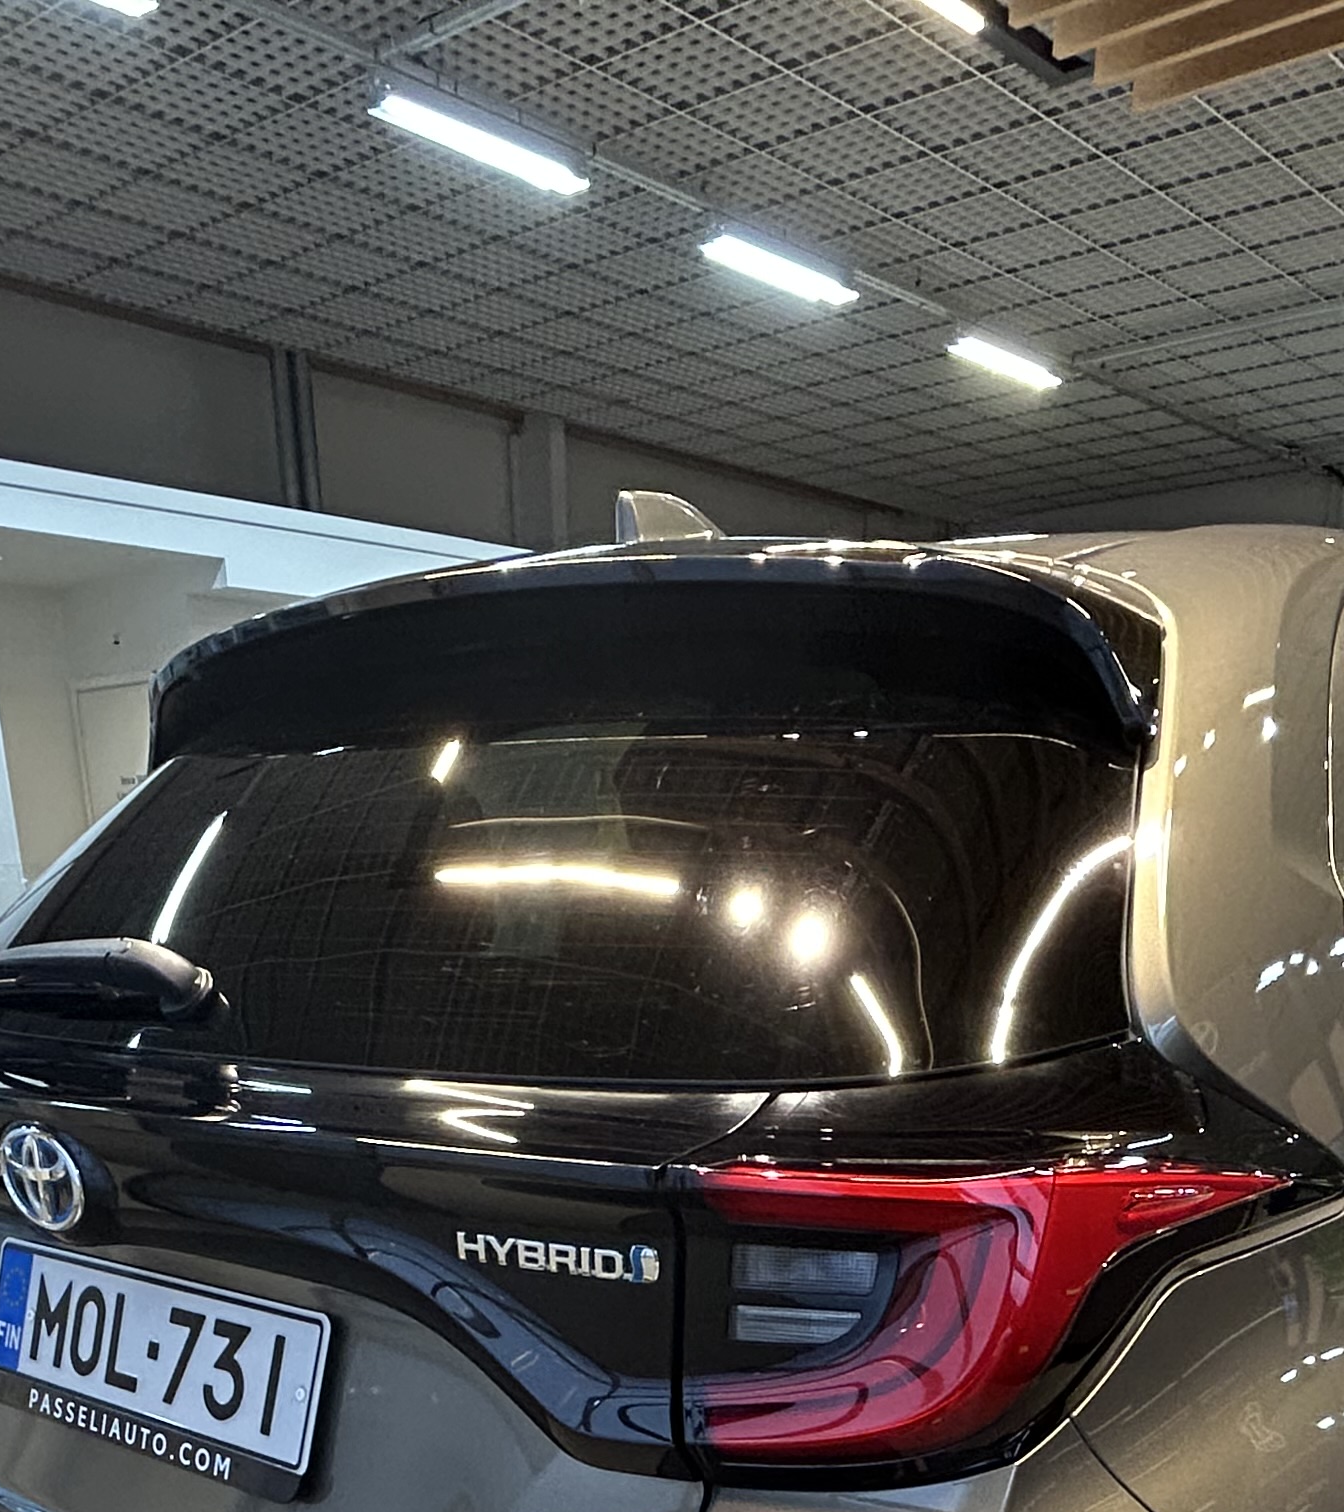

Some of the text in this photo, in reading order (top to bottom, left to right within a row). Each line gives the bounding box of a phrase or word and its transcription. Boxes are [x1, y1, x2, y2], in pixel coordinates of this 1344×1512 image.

[456, 1231, 625, 1280] HYBRID
[29, 1273, 285, 1437] MOL-731
[28, 1389, 231, 1481] PASSELIAUTO.COM
